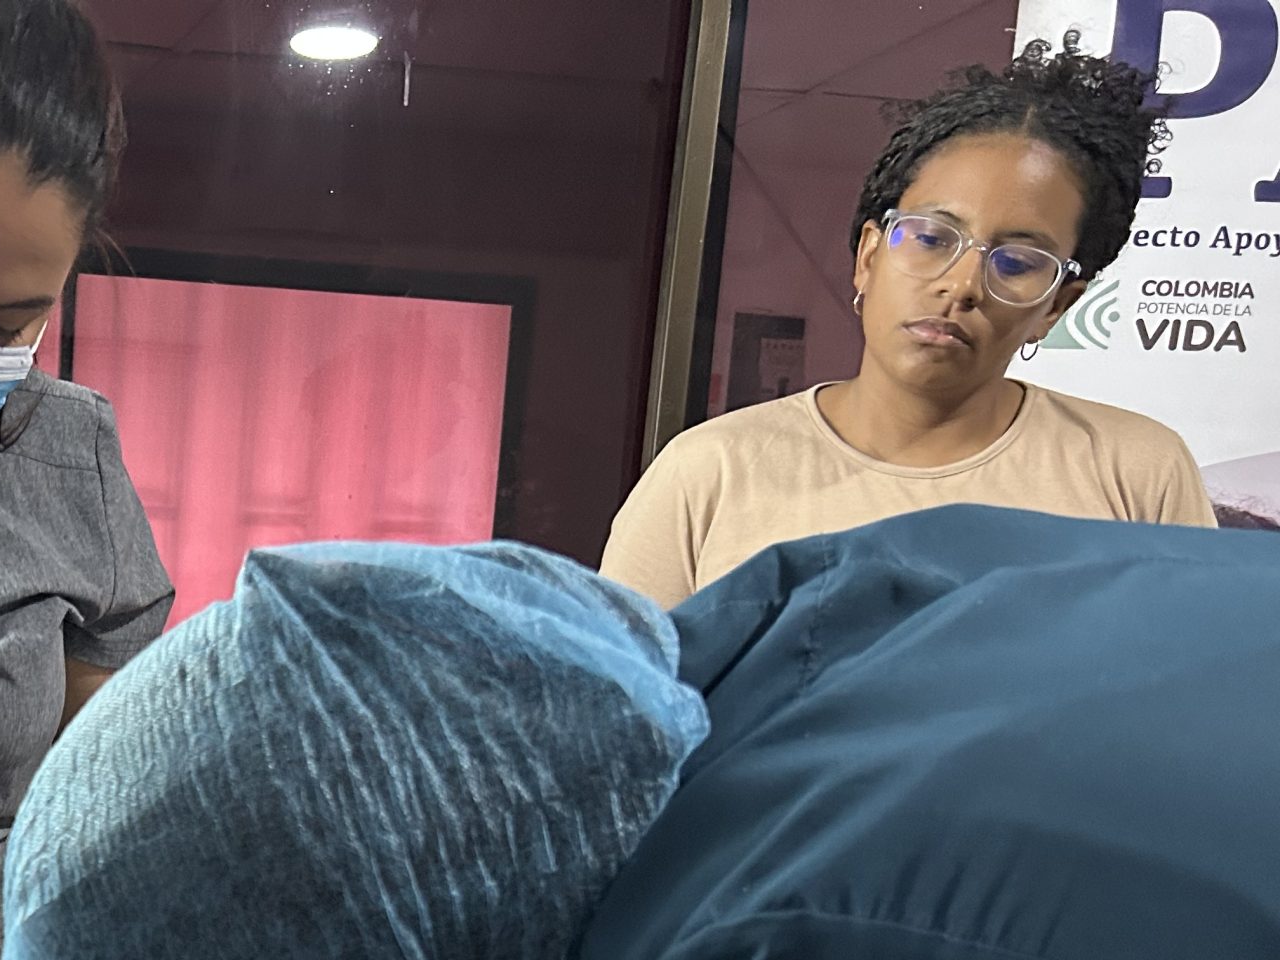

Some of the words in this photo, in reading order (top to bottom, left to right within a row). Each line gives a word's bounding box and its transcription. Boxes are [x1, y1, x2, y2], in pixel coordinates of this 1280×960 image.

[1142, 280, 1255, 299] COLOMBIA
[1137, 302, 1209, 315] POTENCIA
[1213, 303, 1232, 316] DE
[1234, 305, 1252, 317] LA
[1135, 318, 1247, 353] VIDA
